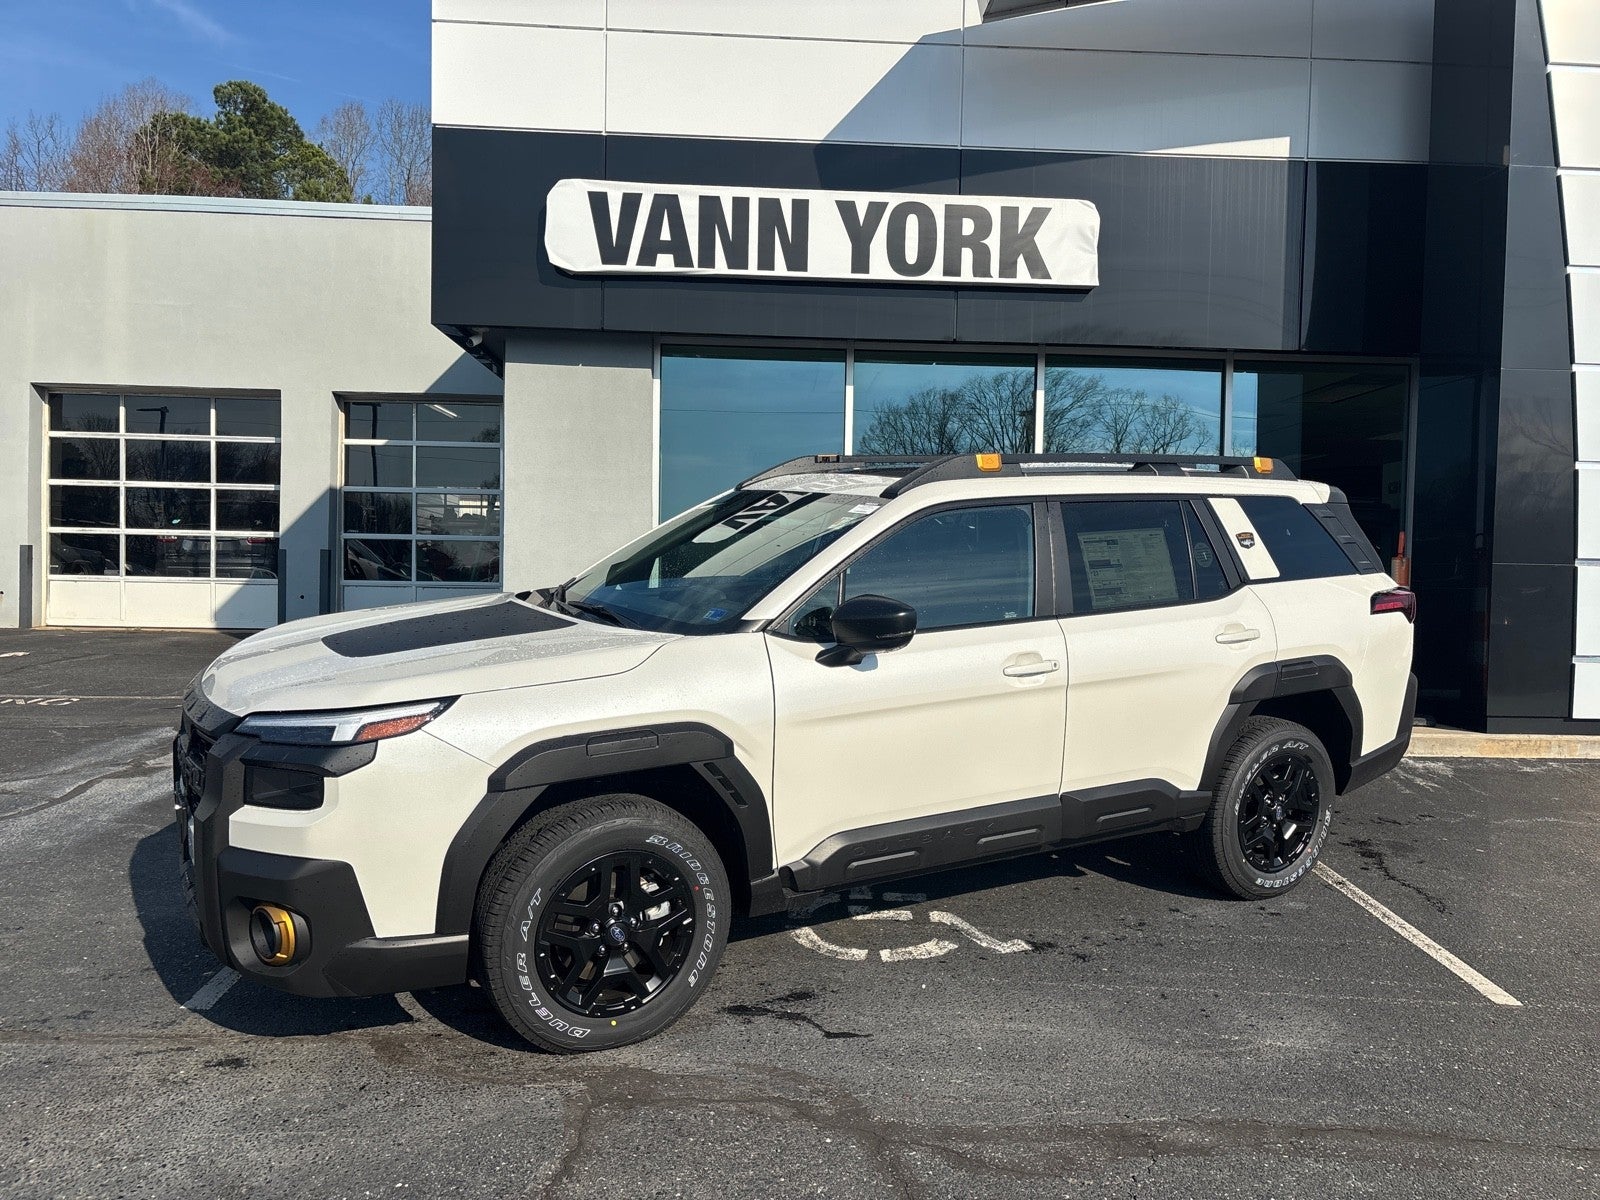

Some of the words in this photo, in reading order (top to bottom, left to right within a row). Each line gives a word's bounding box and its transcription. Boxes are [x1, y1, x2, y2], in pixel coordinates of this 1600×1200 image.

[587, 190, 810, 273] VANN
[836, 199, 1053, 280] YORK
[853, 822, 995, 856] OUTBACK
[520, 887, 543, 942] A/T
[646, 834, 716, 988] BRIDGESTONE
[517, 952, 591, 1039] DUELER
